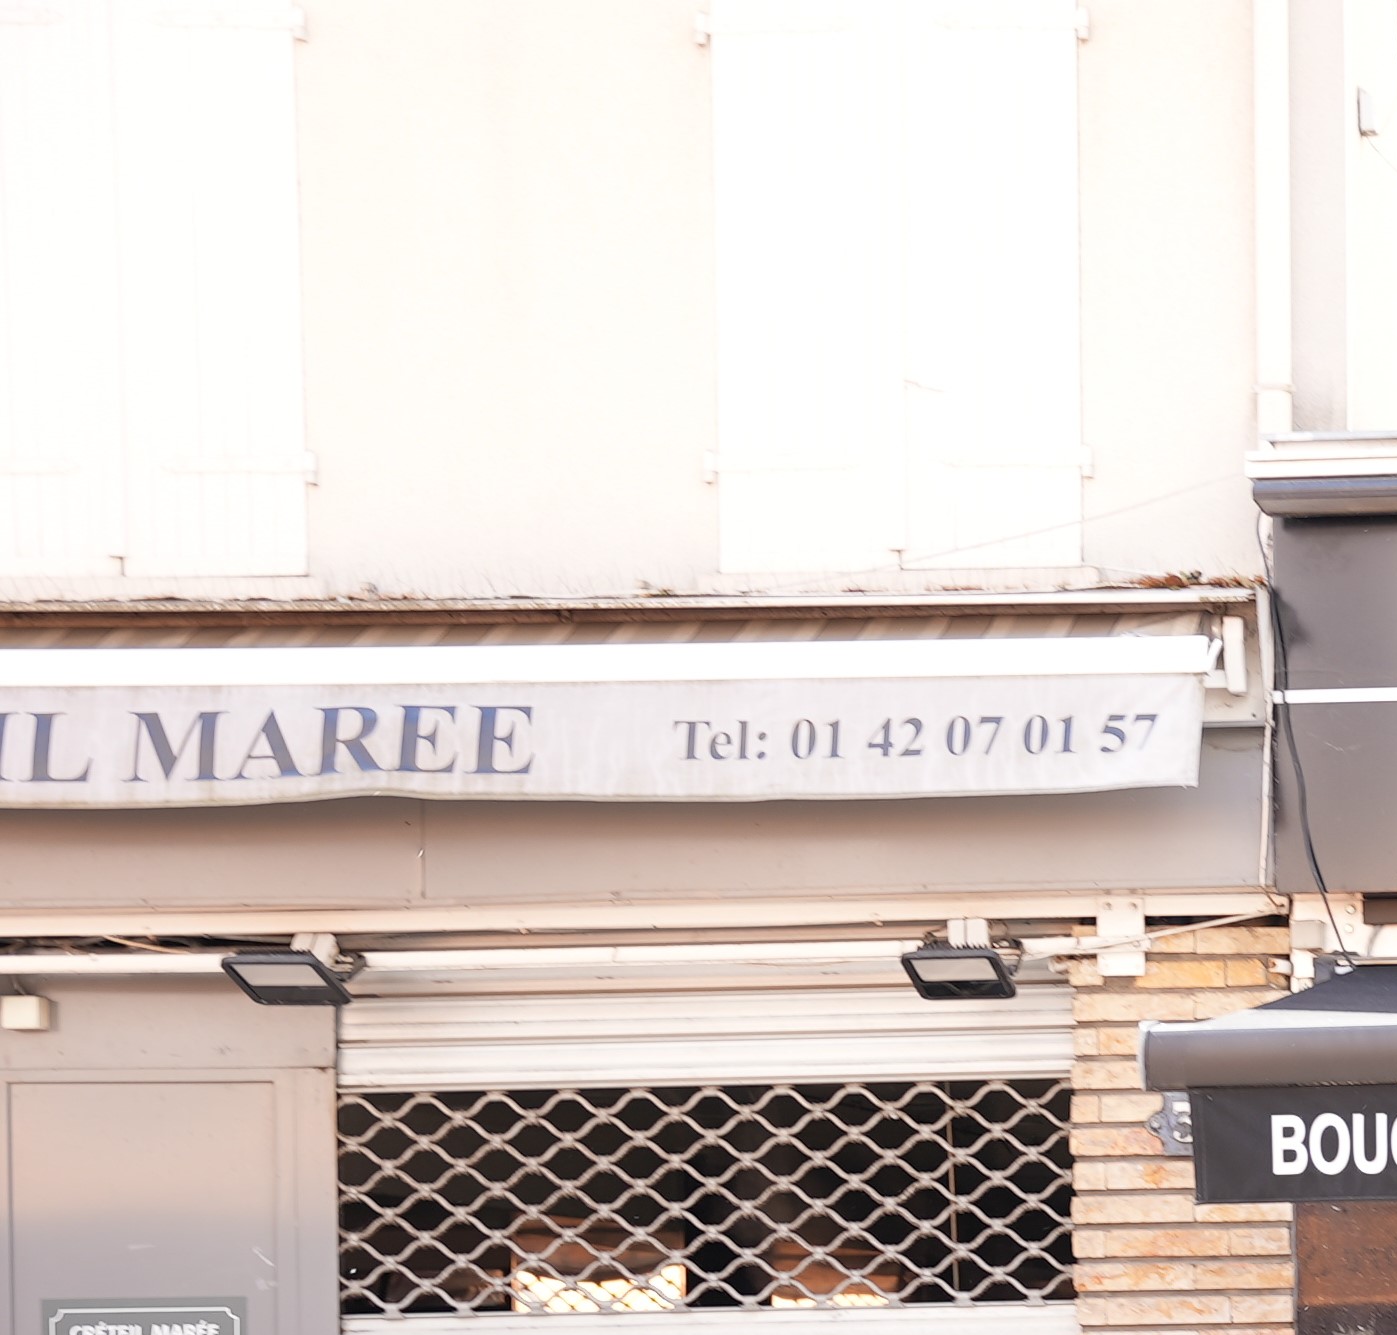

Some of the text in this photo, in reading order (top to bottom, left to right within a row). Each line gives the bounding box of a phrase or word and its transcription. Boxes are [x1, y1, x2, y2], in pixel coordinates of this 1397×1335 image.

[122, 704, 534, 783] MAREE
[673, 713, 1159, 761] Tel: 01 42 07 01 57
